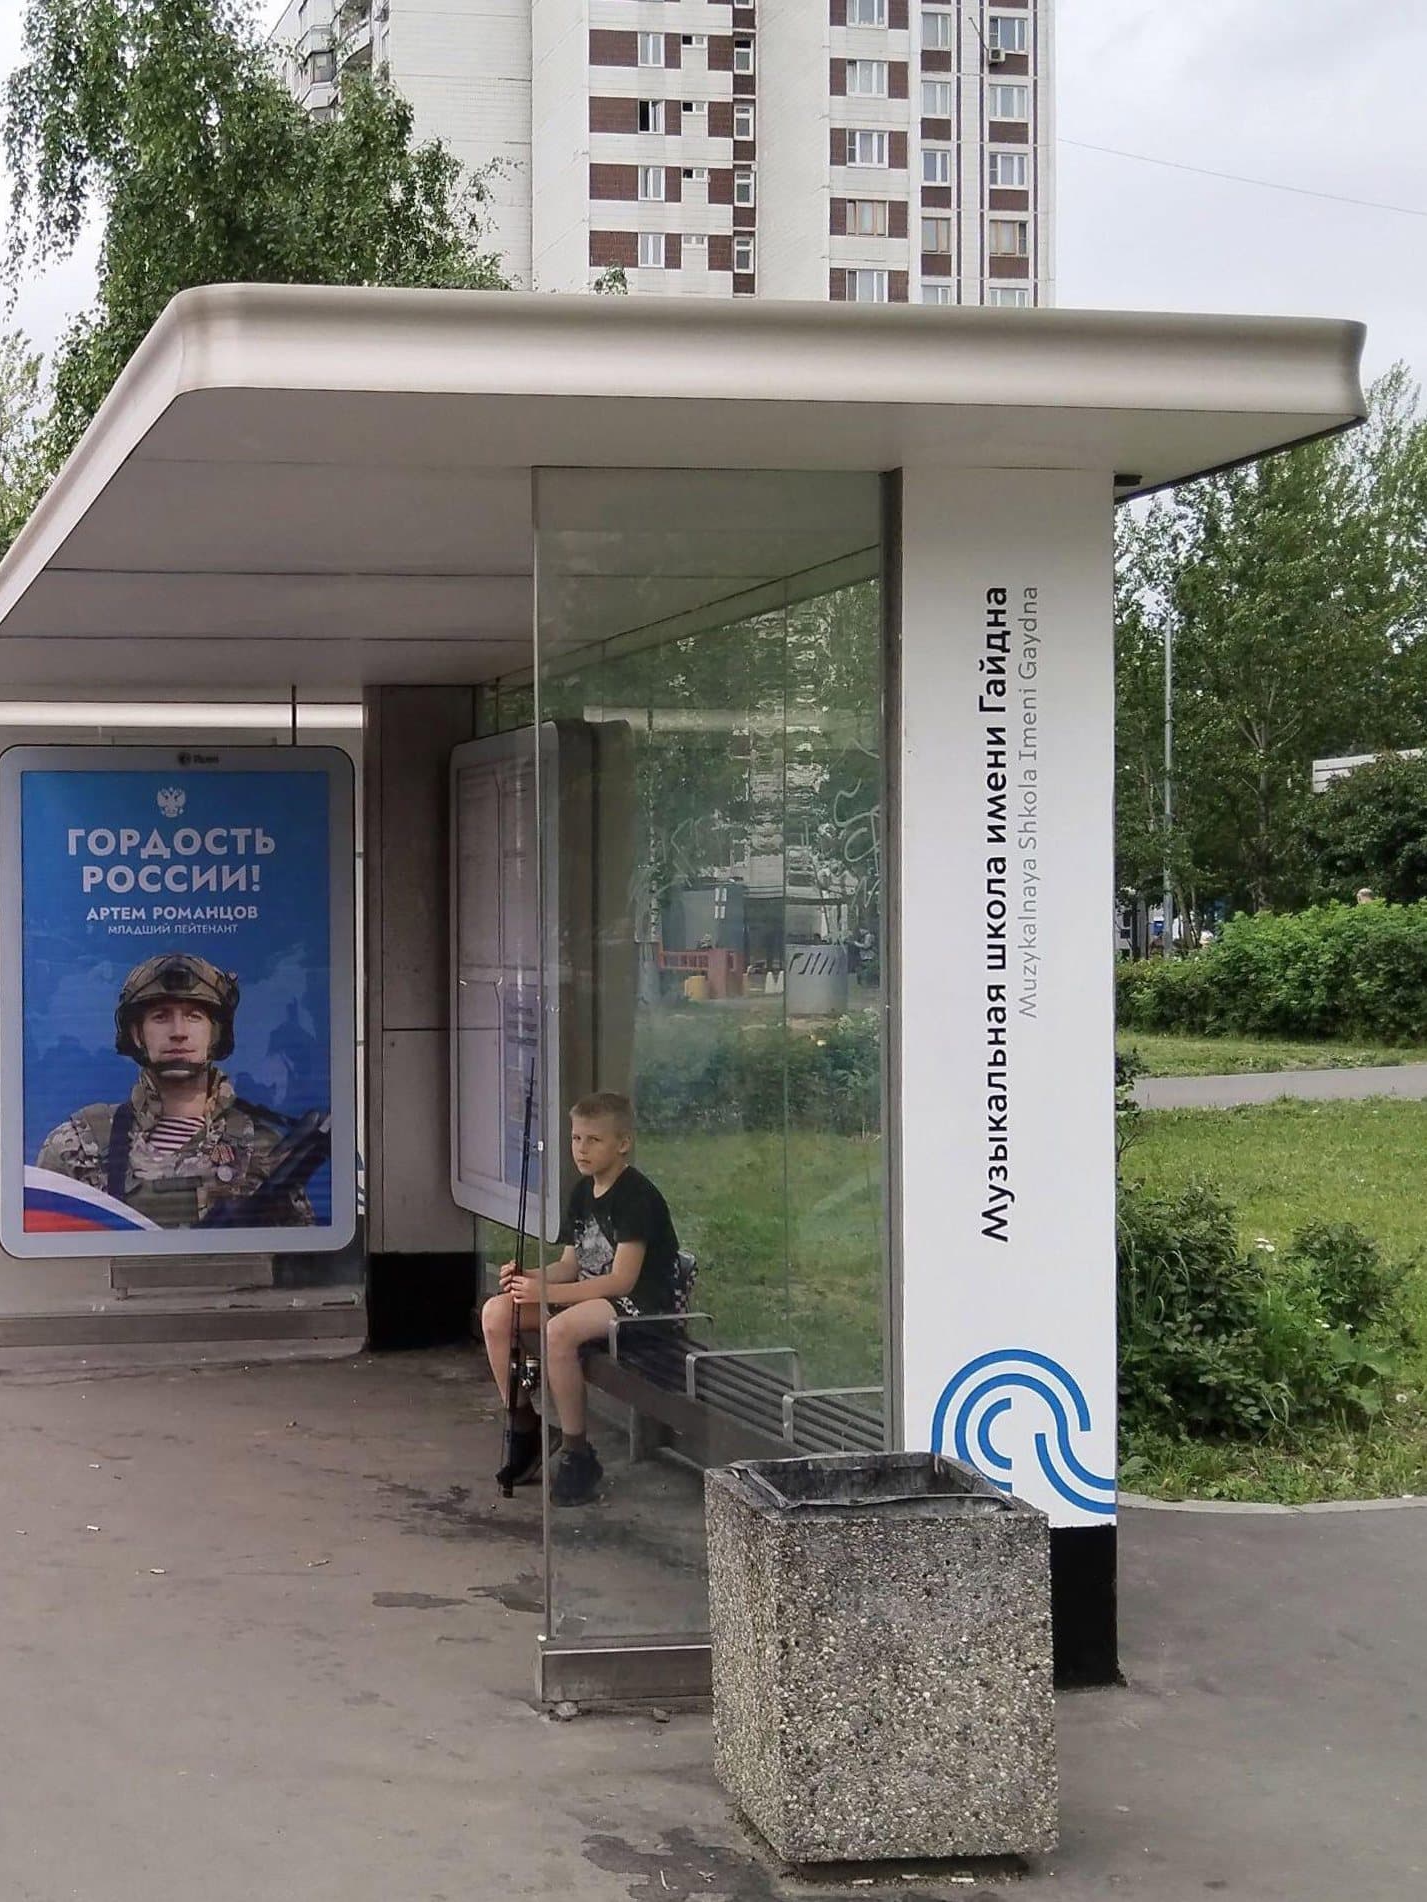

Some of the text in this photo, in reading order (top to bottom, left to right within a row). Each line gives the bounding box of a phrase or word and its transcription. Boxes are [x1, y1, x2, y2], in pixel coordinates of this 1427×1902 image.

[1017, 586, 1042, 1018] Muzykalnaya Shkola Imeni Gaydna
[67, 827, 276, 859] ГОРДОСТЬ
[82, 864, 261, 893] РОССИИ!
[86, 906, 259, 921] АРТЕМ РОМАНЦОВ
[978, 586, 1016, 1243] Музыкальная школа имени Гайдна
[108, 923, 239, 936] МЛАДШИЙ ЛЕЙТЕНАНТ
